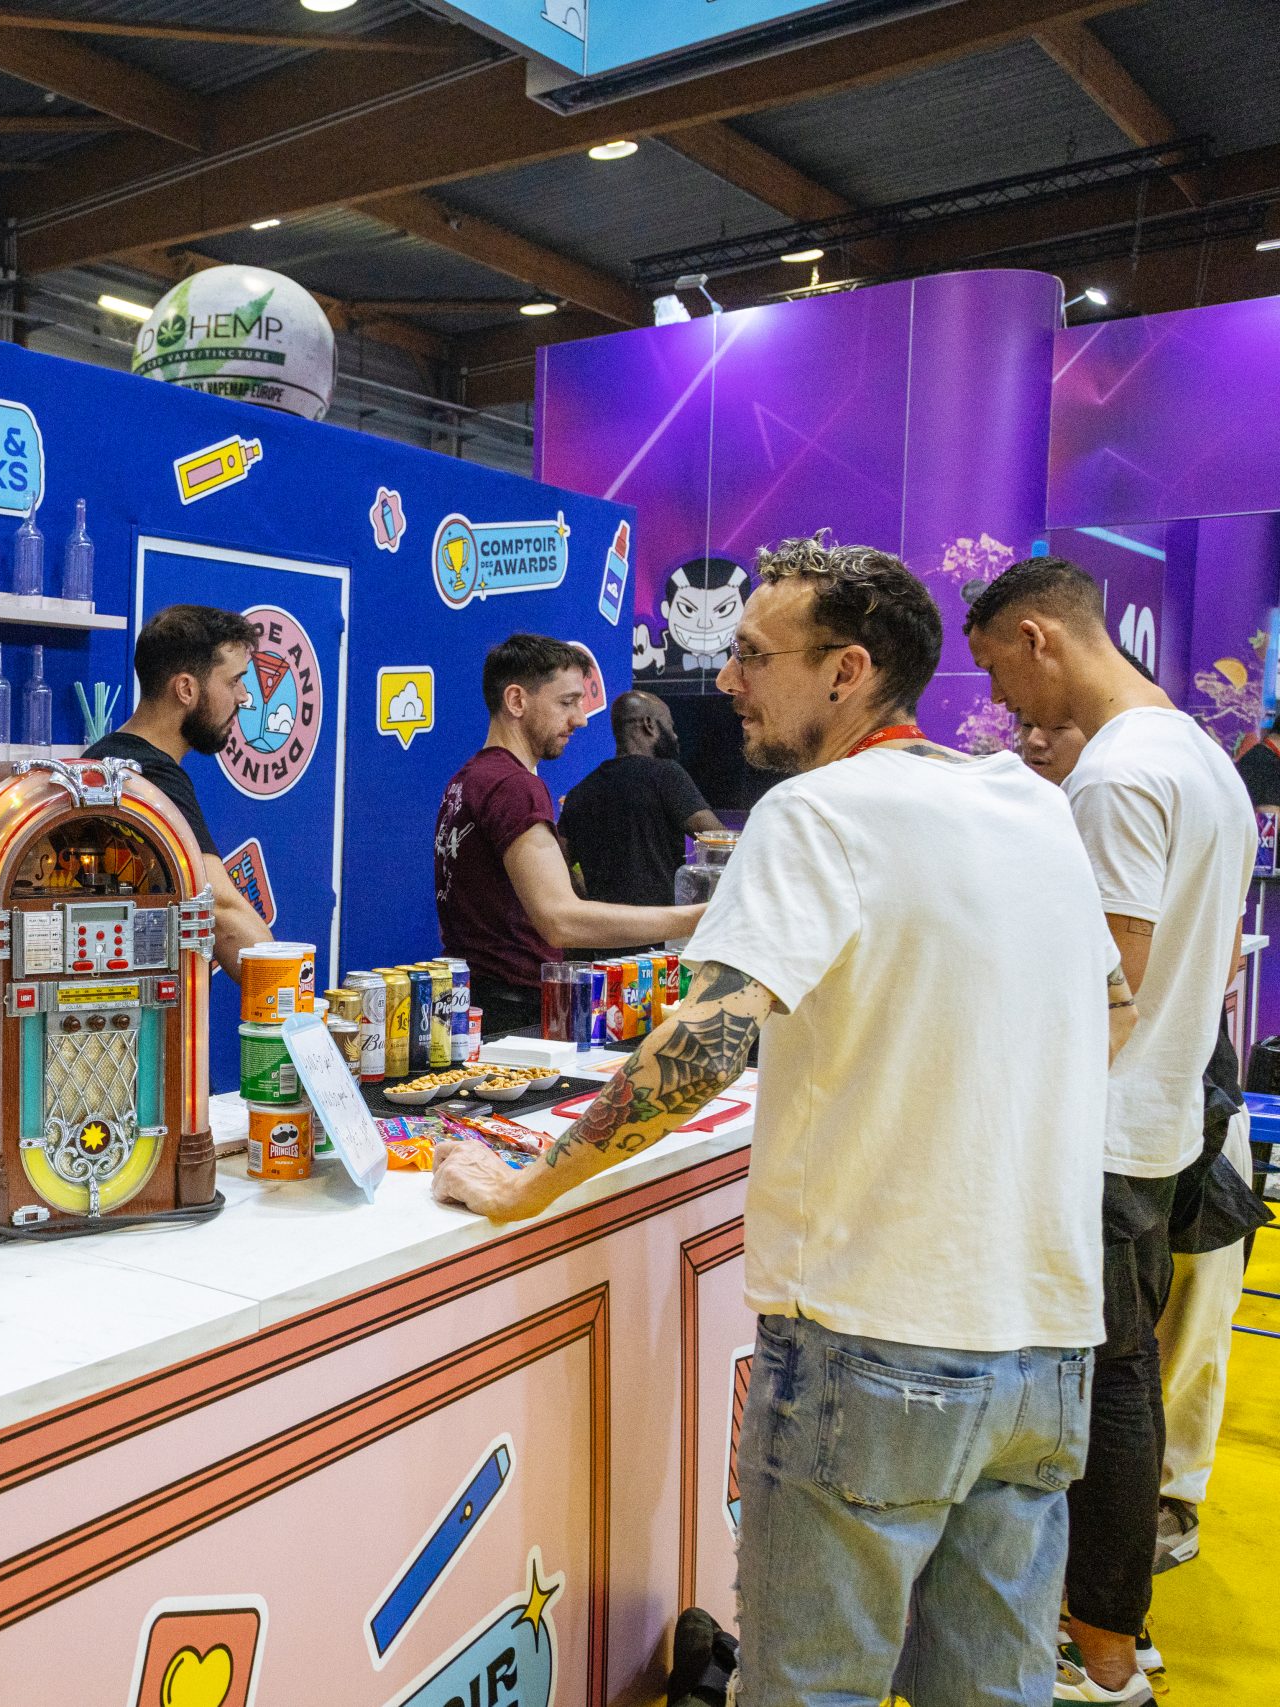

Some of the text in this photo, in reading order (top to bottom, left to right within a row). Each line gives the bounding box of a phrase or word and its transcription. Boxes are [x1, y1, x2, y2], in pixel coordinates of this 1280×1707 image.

[189, 313, 283, 342] HEMP
[251, 384, 285, 402] EUROPE
[4, 427, 28, 458] &
[480, 537, 557, 557] COMPTOIR
[493, 556, 557, 576] AWARDS
[288, 642, 314, 727] AND
[225, 736, 305, 784] DRINK
[270, 1144, 299, 1158] PRINGLES
